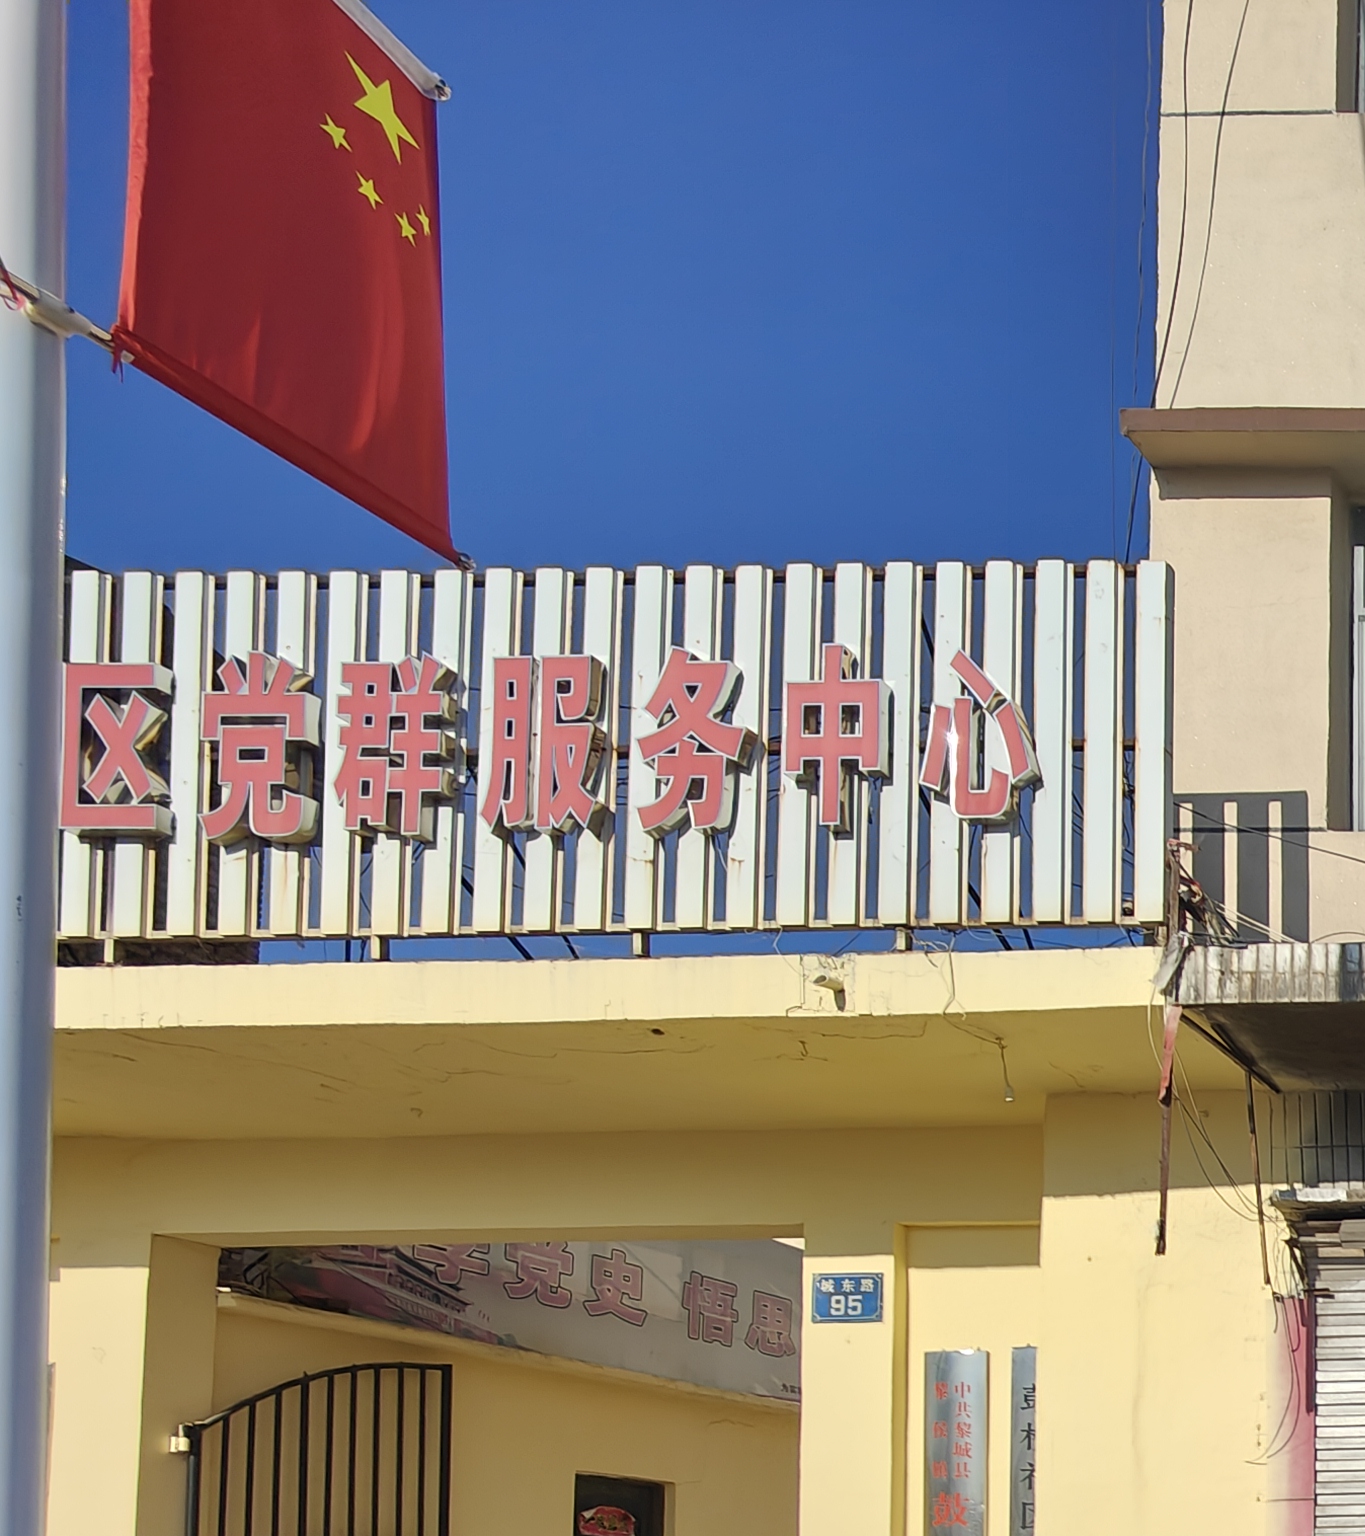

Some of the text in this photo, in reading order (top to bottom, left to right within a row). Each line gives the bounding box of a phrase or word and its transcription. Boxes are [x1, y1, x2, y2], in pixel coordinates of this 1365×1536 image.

[58, 646, 1042, 842] 区党群服务中心
[829, 1294, 864, 1317] 95
